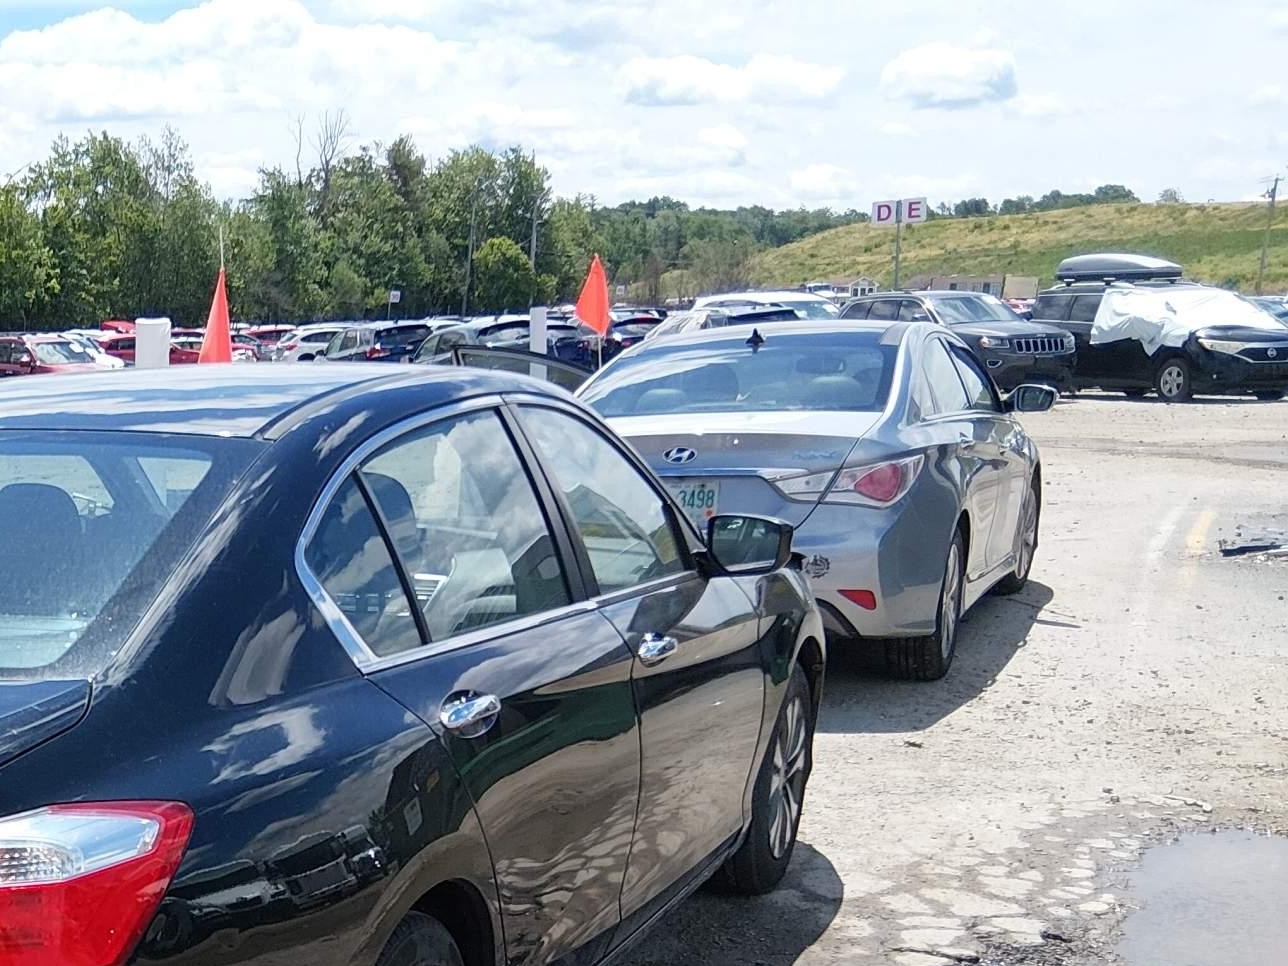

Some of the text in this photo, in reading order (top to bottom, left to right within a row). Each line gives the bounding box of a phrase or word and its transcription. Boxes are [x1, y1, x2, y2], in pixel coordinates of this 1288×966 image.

[877, 204, 892, 222] D
[908, 201, 921, 218] E
[678, 489, 715, 509] 3498
